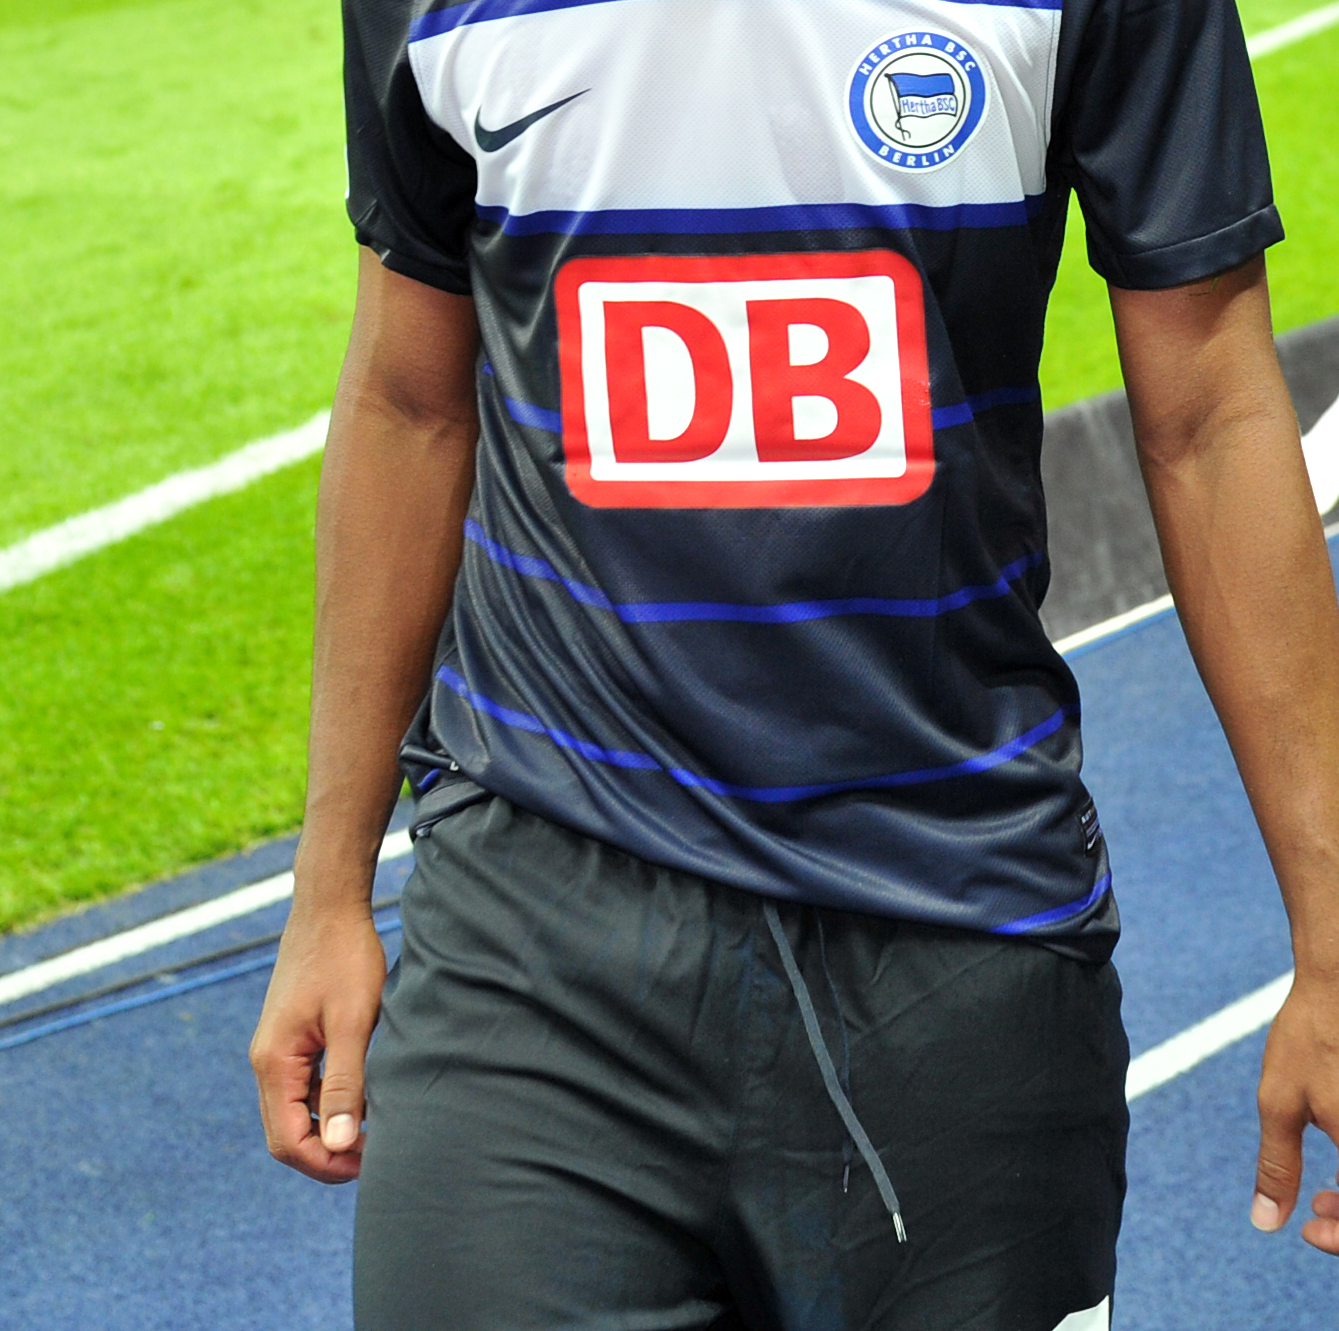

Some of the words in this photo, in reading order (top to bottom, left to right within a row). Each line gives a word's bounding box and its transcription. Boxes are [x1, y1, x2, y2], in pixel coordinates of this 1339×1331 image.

[858, 33, 933, 75] HERTHA
[944, 41, 976, 72] BSC
[878, 144, 956, 167] BERLIN
[603, 297, 882, 464] DB
